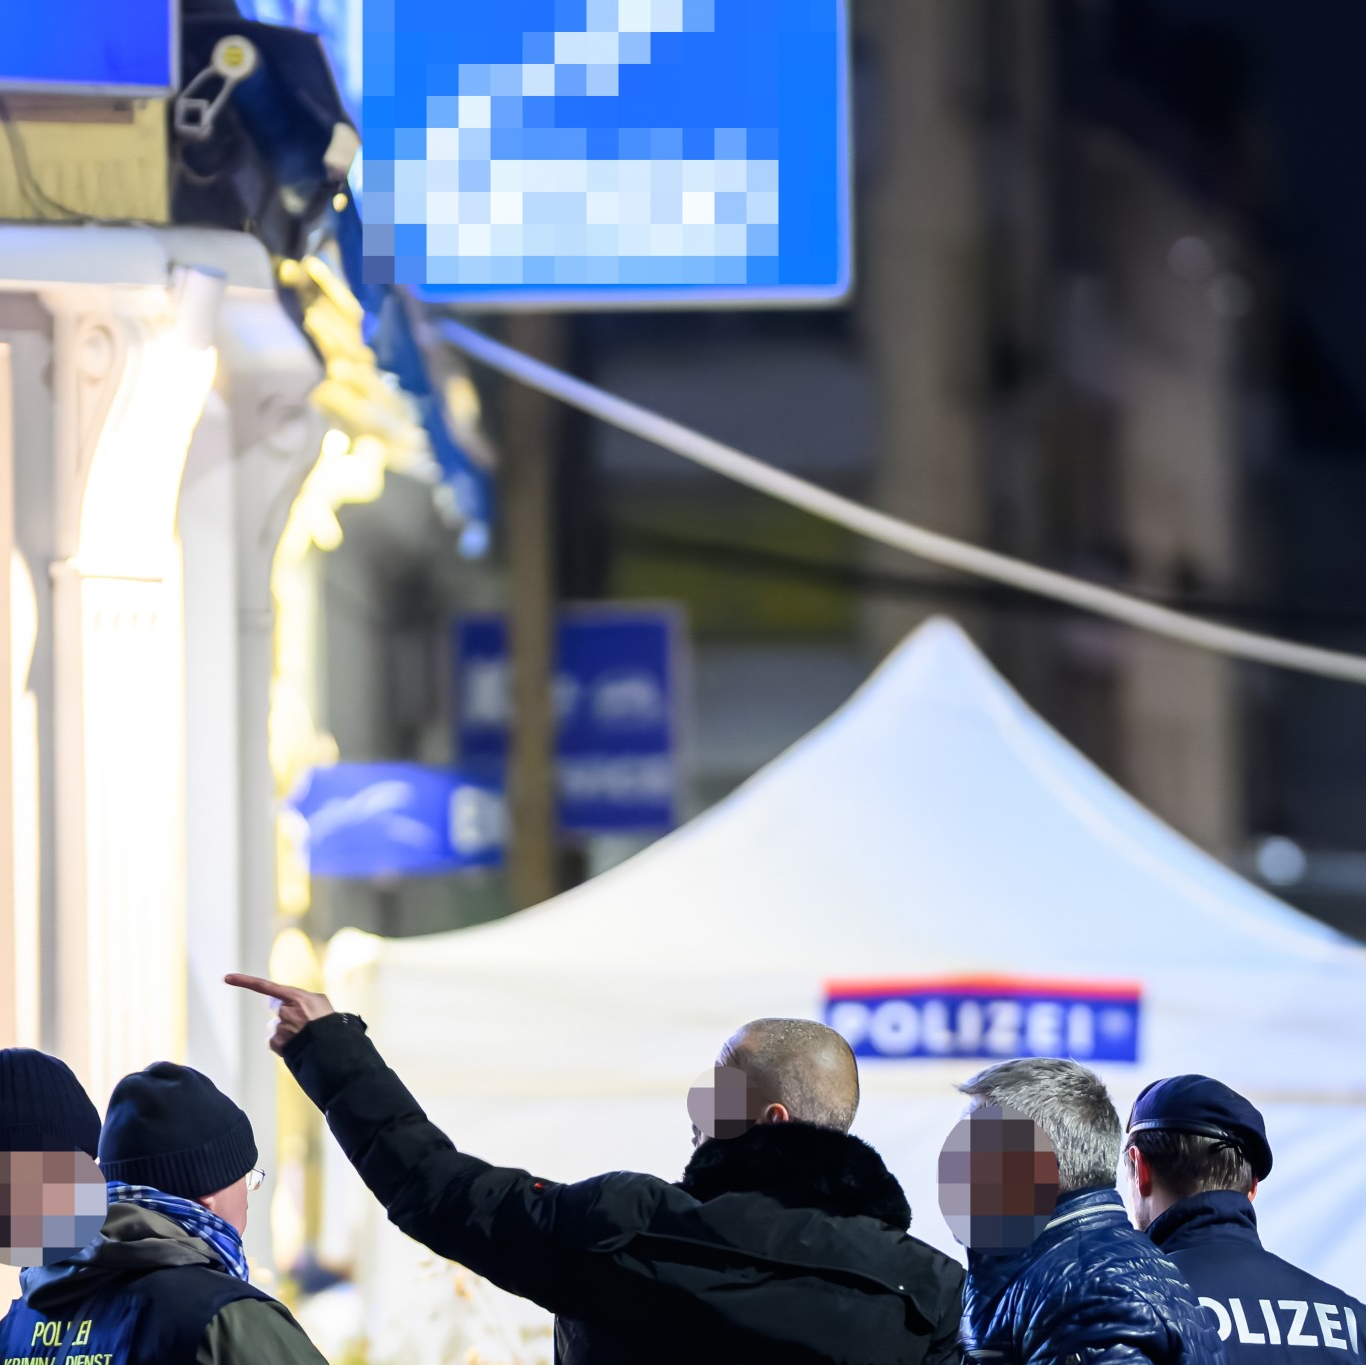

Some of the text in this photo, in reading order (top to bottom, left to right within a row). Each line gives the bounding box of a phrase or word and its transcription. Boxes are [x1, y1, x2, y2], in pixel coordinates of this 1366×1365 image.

[828, 999, 1095, 1056] POLIZEI
[30, 1319, 93, 1348] POLEI
[1197, 1296, 1359, 1355] OLIZEI
